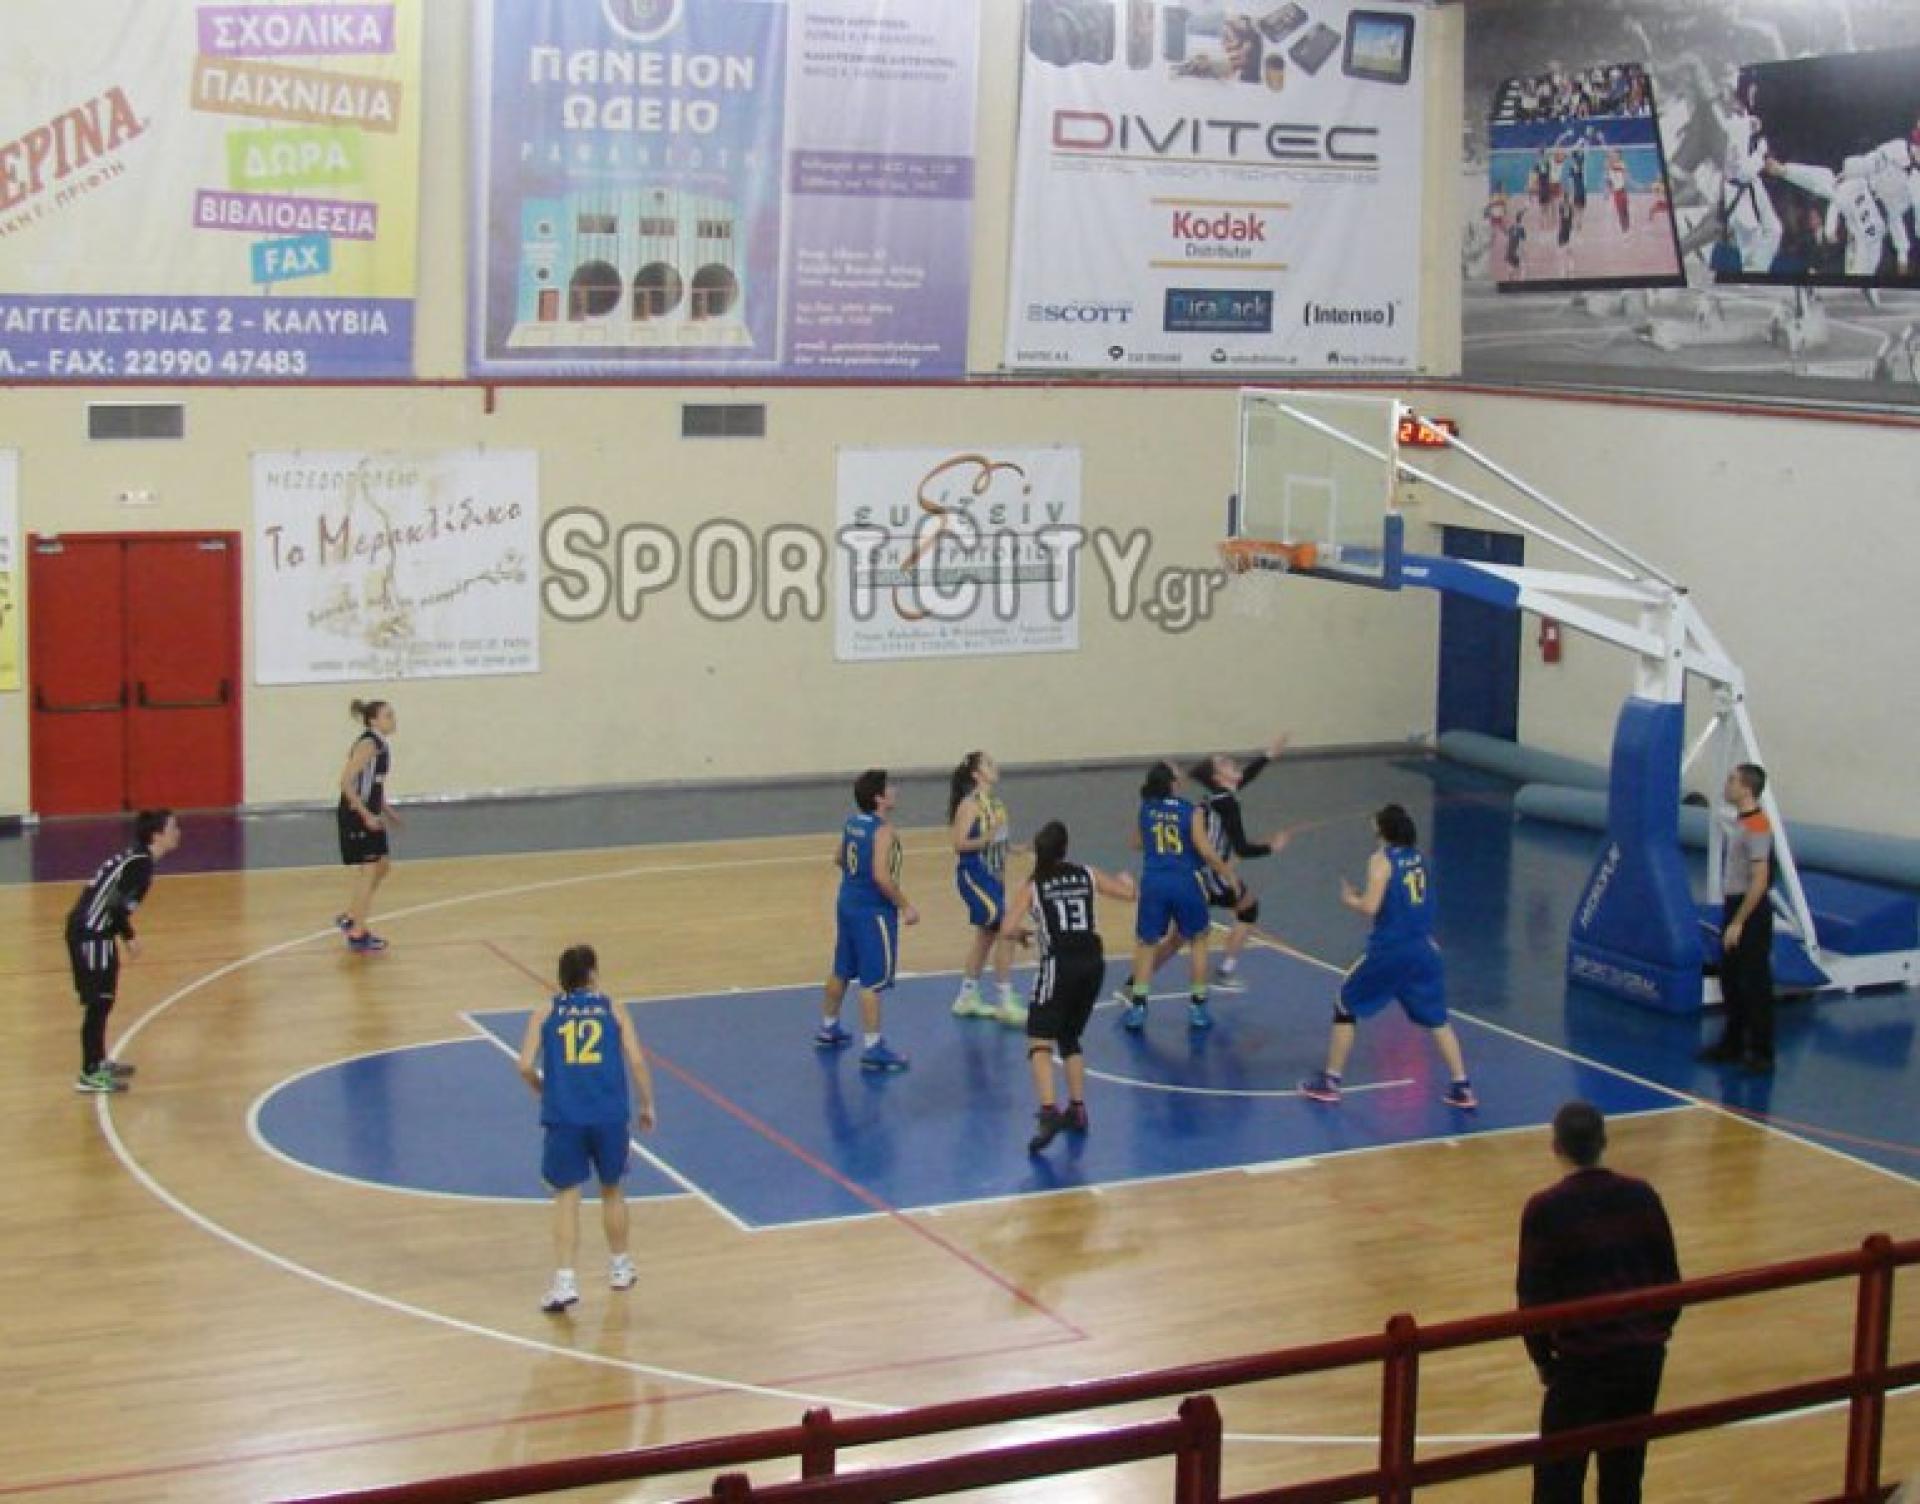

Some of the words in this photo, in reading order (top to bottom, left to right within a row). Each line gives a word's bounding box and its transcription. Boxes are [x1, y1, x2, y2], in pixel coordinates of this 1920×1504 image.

[213, 13, 383, 49] ΣΧΟΛΙΚΑ
[529, 45, 754, 91] ΠΑΝΕΙΟΝ
[201, 70, 392, 121] ΠΑΙΧΝΙΔΙΑ
[1052, 110, 1380, 162] DIVITEC
[243, 141, 351, 178] ΔΩΡΑ
[200, 199, 376, 234] ΒΙΒΛΙΟΔΕΣΙΑ
[1172, 210, 1267, 242] Kodak
[264, 246, 321, 274] FAX
[1185, 243, 1252, 259] Distributor
[216, 309, 233, 334] 2
[264, 309, 389, 336] ΚΑΛΥΒΙΑ
[49, 350, 115, 375] FAX:
[124, 350, 212, 376] 22990
[222, 351, 308, 376] 47483
[1054, 899, 1089, 931] 13
[557, 1019, 603, 1064] 12
